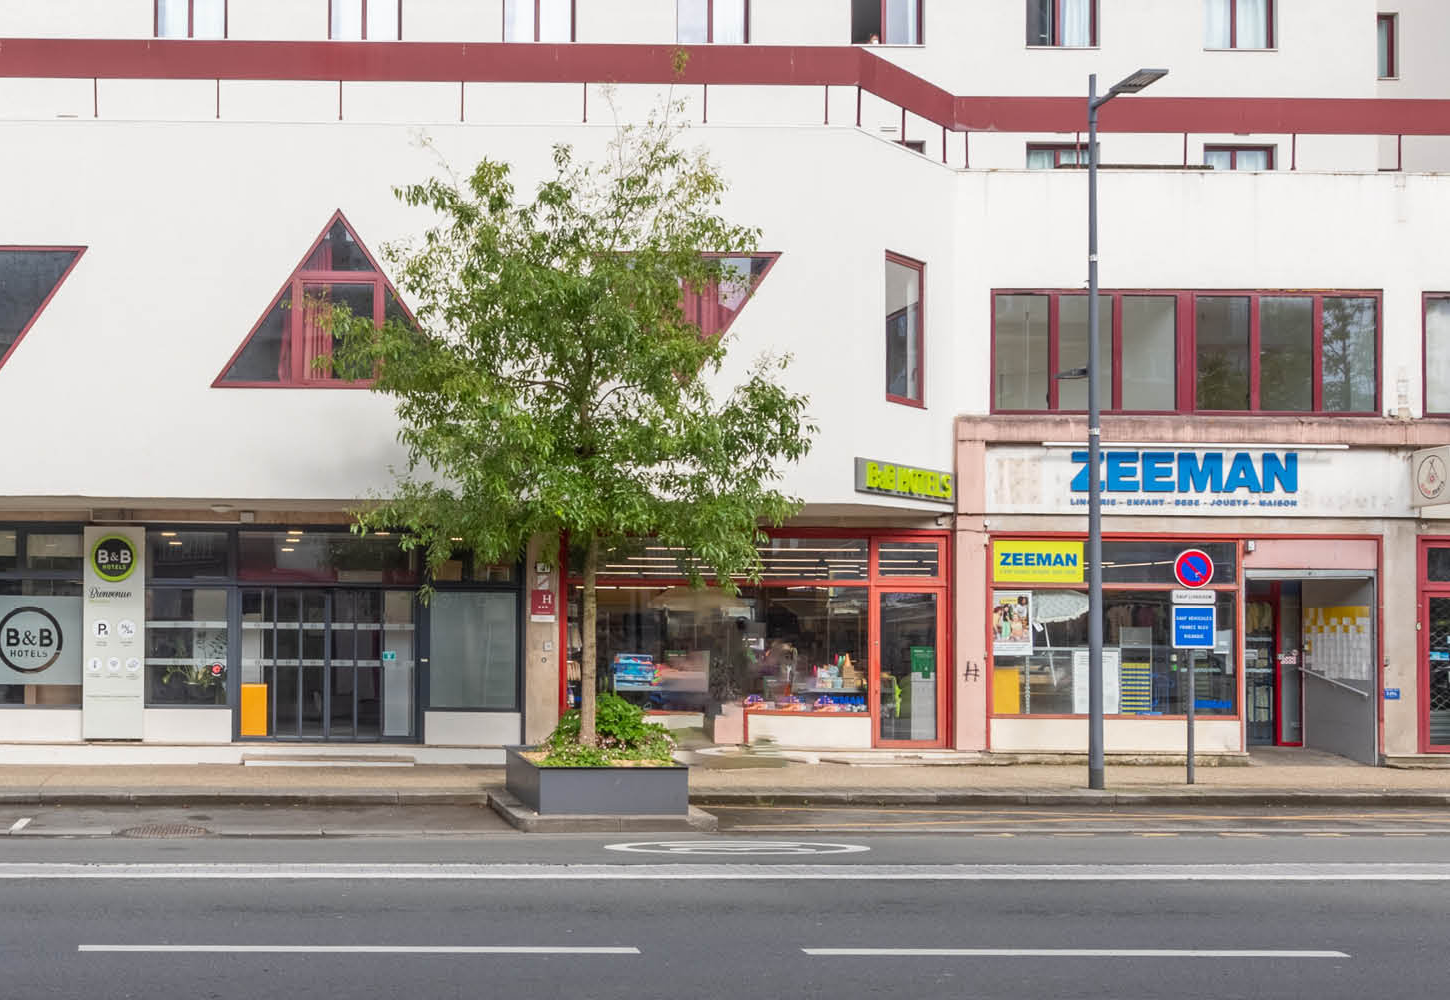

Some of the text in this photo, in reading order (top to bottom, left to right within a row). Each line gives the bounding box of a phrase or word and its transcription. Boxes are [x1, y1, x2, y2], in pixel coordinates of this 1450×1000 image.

[1070, 451, 1299, 494] ZEEMAN
[97, 549, 132, 564] B&B
[999, 552, 1078, 567] ZEEMAN
[542, 594, 552, 605] H
[6, 628, 54, 648] B&B
[10, 649, 48, 658] HOTELS
